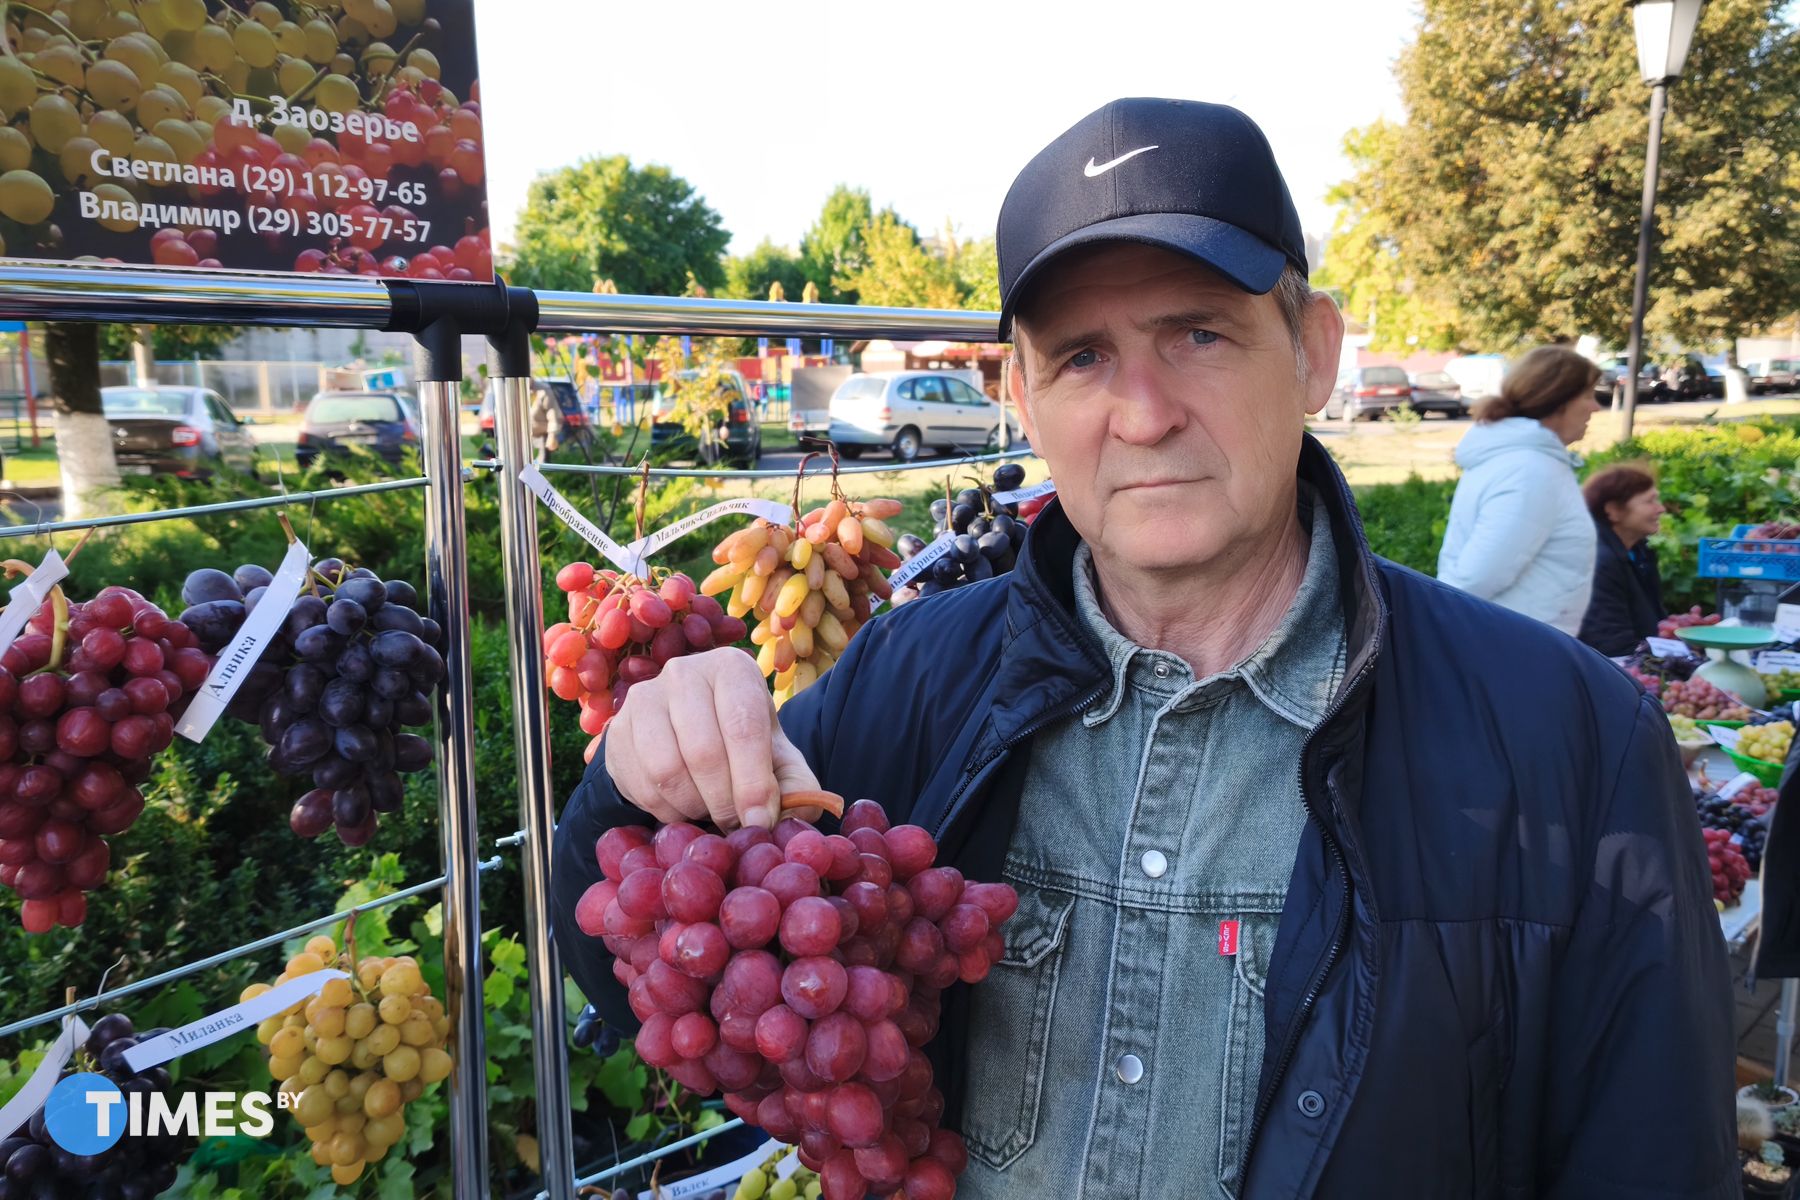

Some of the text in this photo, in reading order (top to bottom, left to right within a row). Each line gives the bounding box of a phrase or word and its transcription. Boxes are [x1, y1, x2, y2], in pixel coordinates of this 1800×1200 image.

[230, 95, 418, 144] д. Заозерье
[90, 149, 427, 205] Светлана (29) 112-97-65
[80, 192, 431, 242] Владимир (29) 305-77-57
[543, 488, 609, 551] Преображение
[209, 635, 257, 697] Алвика
[169, 1011, 244, 1049] Миланка
